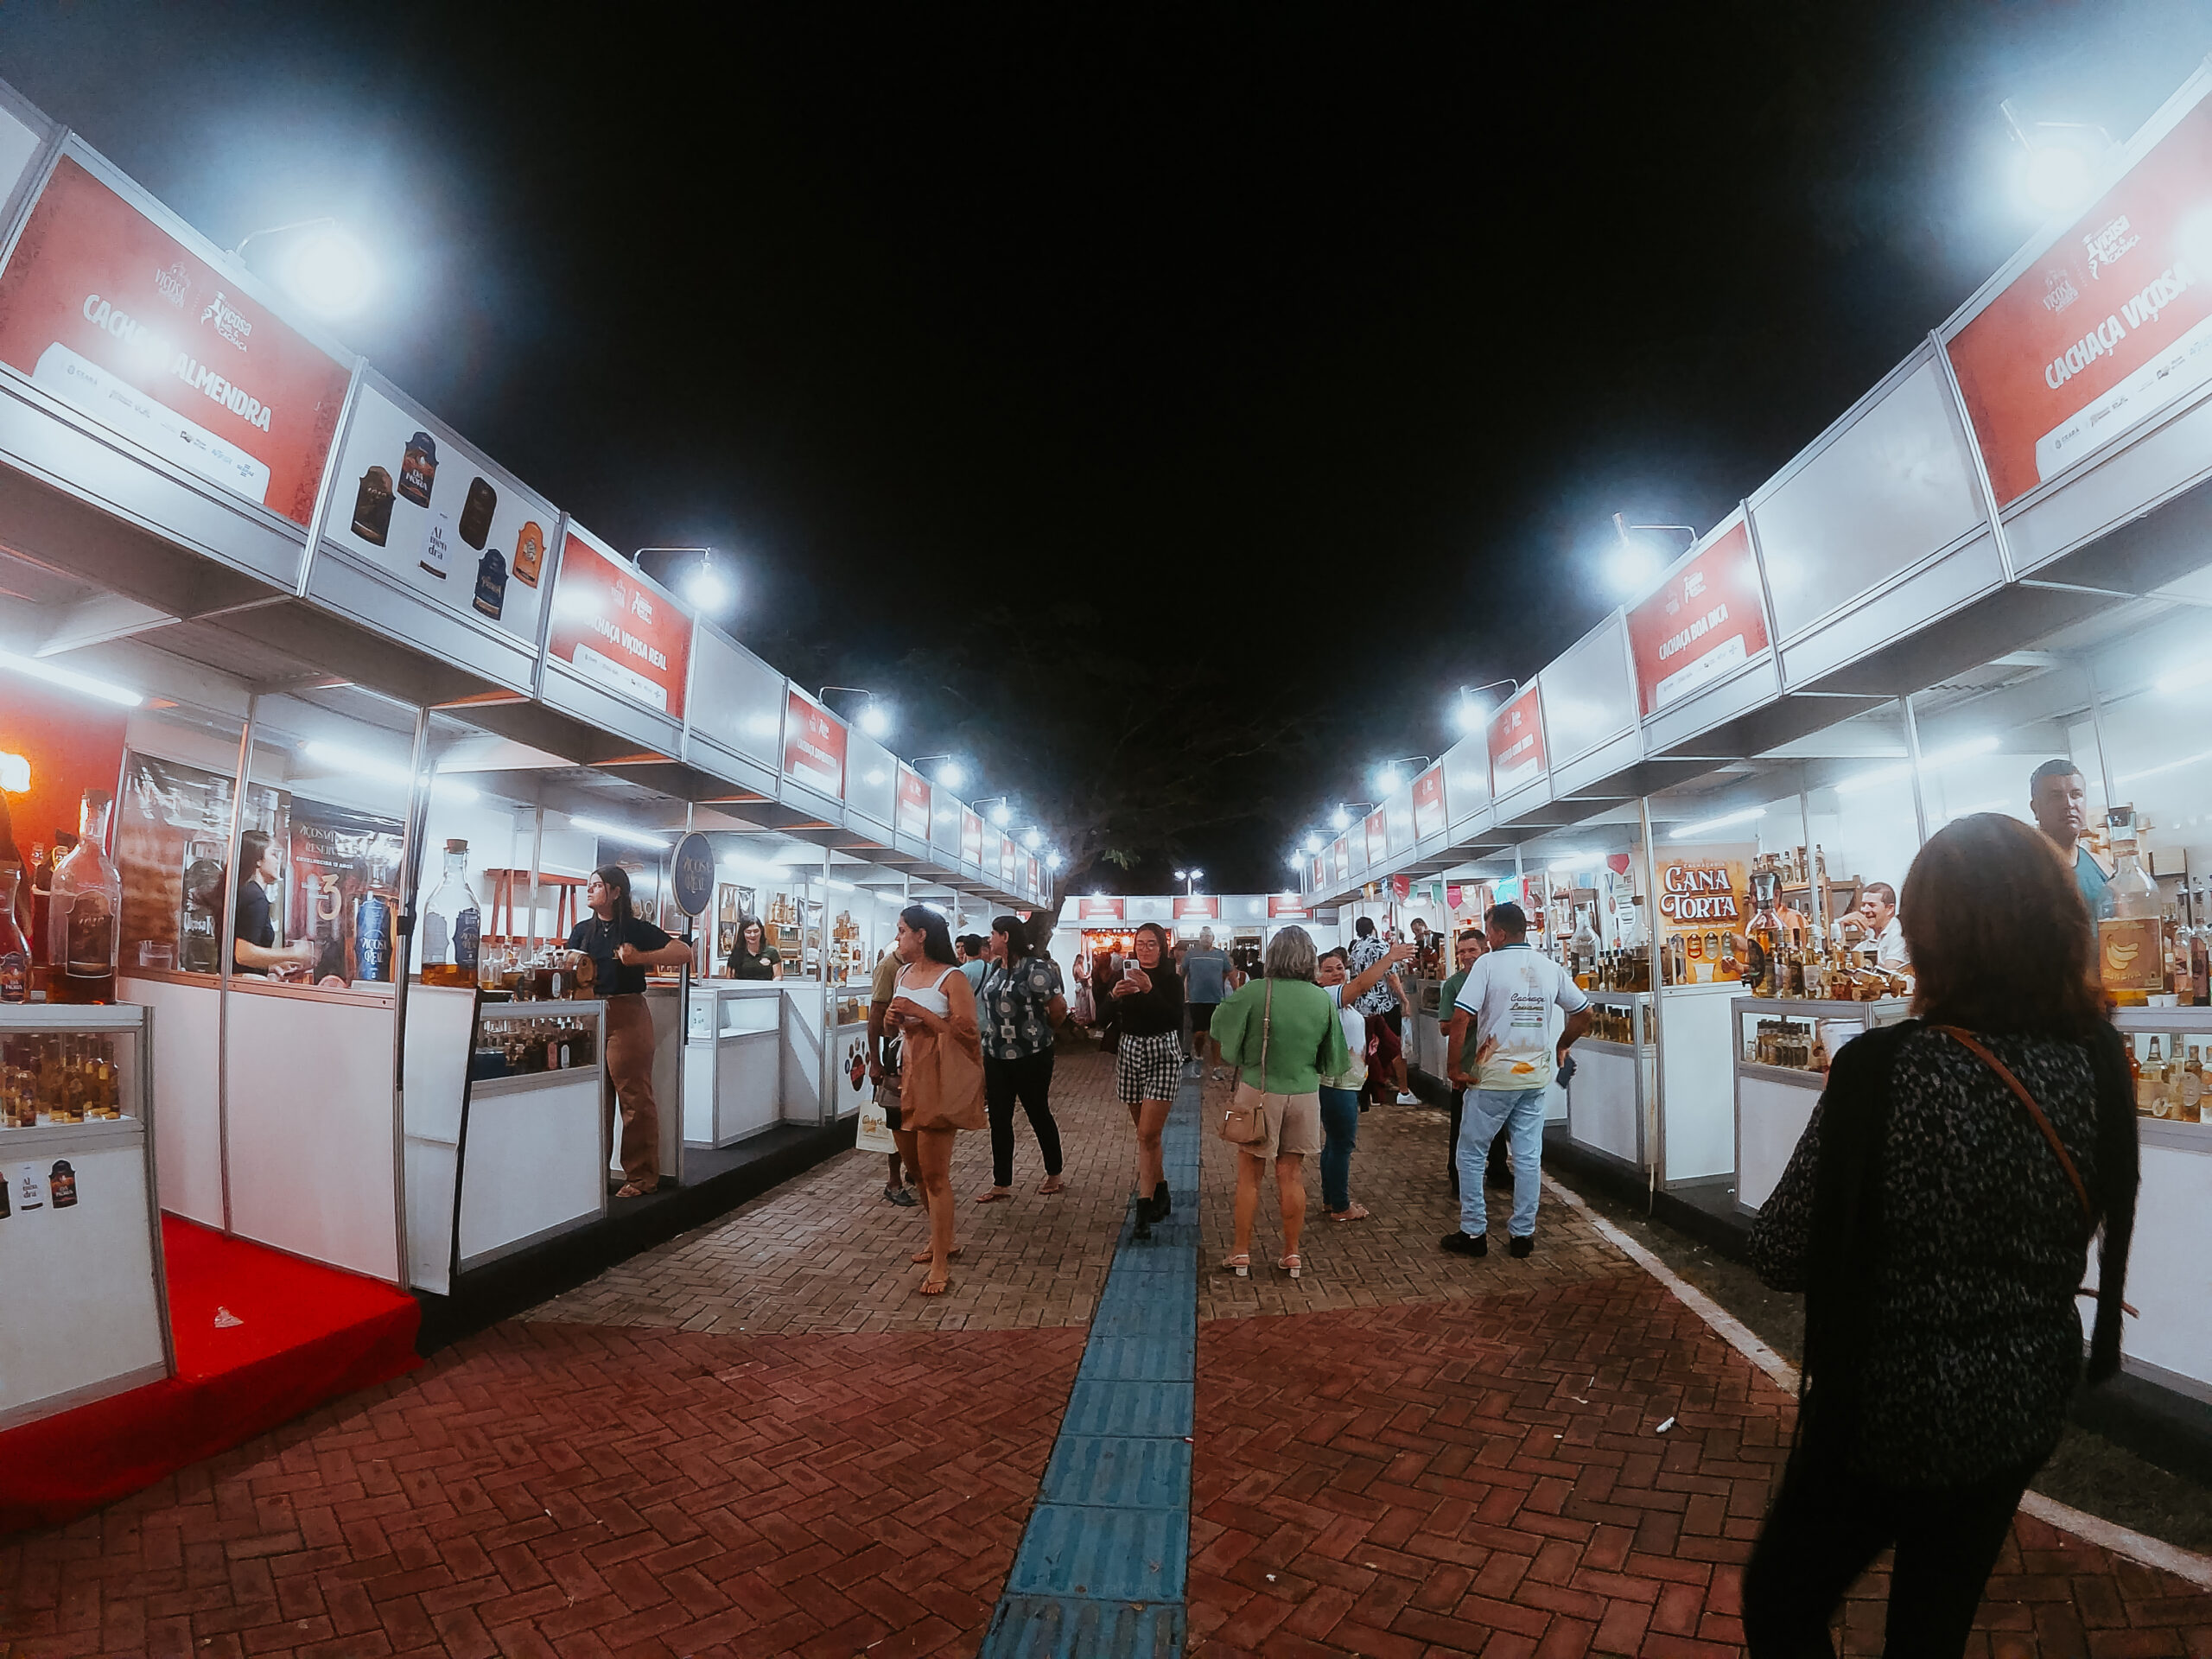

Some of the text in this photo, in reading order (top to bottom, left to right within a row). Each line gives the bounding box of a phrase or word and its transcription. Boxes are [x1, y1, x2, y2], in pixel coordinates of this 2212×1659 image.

[2044, 315, 2126, 390] CACHAÇA
[173, 353, 272, 433] ALMENDRA
[621, 630, 648, 660] VIÇOSA
[648, 646, 668, 671] REAL
[1665, 867, 1732, 893] CANA
[1661, 892, 1738, 919] TORTA
